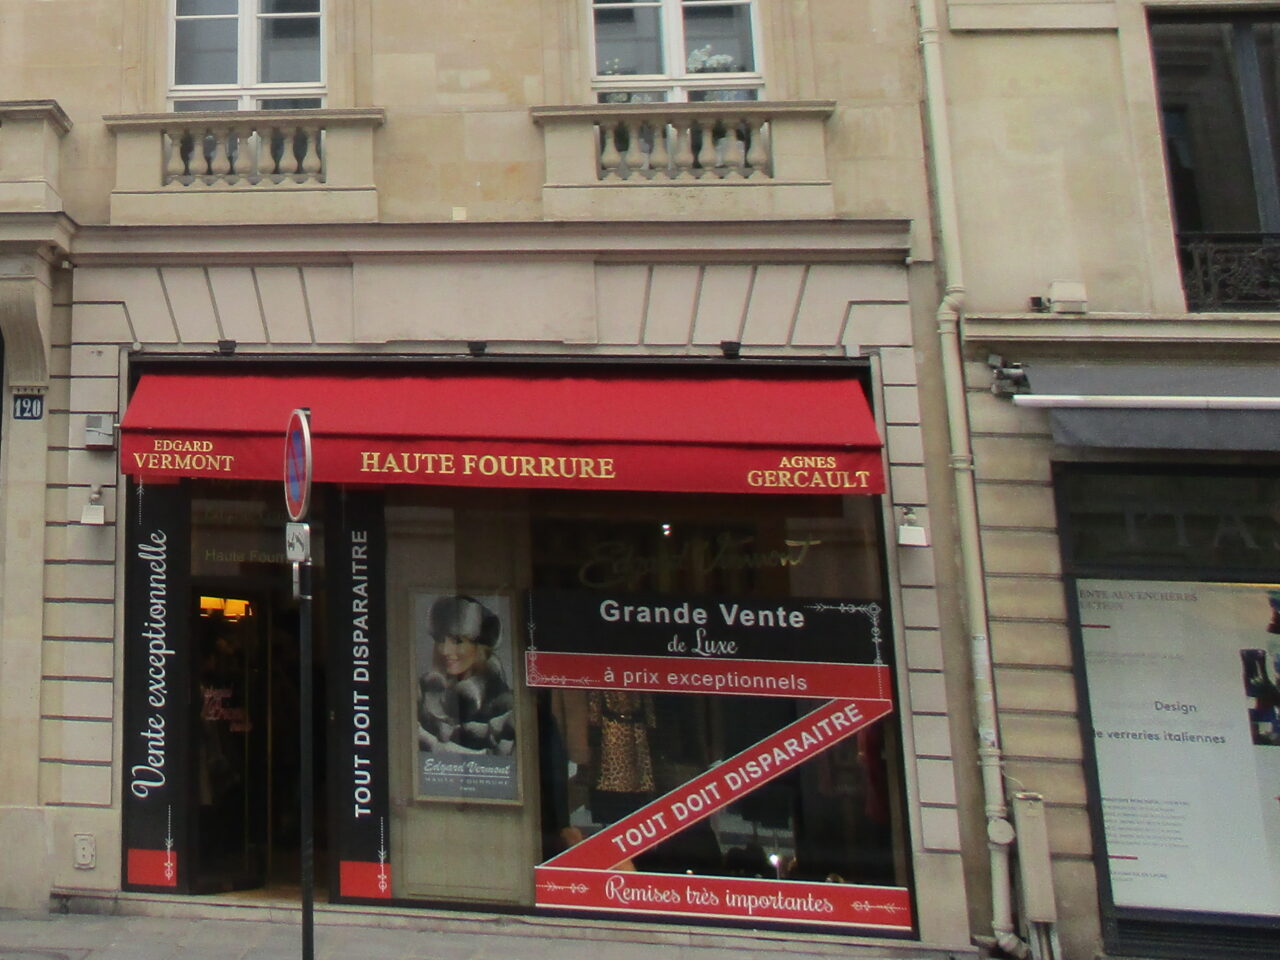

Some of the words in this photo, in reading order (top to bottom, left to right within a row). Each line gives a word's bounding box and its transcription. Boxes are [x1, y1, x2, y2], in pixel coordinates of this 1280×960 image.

[15, 399, 41, 417] 120
[154, 440, 214, 452] EDGARD
[133, 453, 234, 471] VERMONT
[360, 451, 456, 474] HAUTE
[462, 454, 616, 479] FOURRURE
[779, 456, 837, 468] AGNES
[747, 470, 870, 488] GERCAULT
[138, 529, 175, 708] exceptionnelle
[352, 530, 369, 682] DISPARAITRE
[600, 600, 708, 624] Grande
[720, 604, 806, 628] Vente
[667, 634, 687, 653] de
[691, 628, 738, 656] Luxe
[604, 667, 615, 682] à
[623, 669, 659, 686] prix
[667, 671, 808, 690] exceptionnels
[353, 691, 370, 746] DOIT
[1154, 701, 1198, 715] Design
[1107, 729, 1161, 741] verreries
[1163, 731, 1227, 744] italiennes
[131, 713, 166, 798] Vente
[424, 758, 465, 775] Edgard
[466, 761, 510, 775] Vermont
[354, 755, 371, 818] TOUT
[611, 812, 667, 852] TOUT
[671, 782, 721, 821] DOIT
[725, 703, 864, 790] DISPARAITRE
[605, 875, 680, 904] Remises
[686, 885, 720, 905] très
[726, 890, 834, 915] importantes
